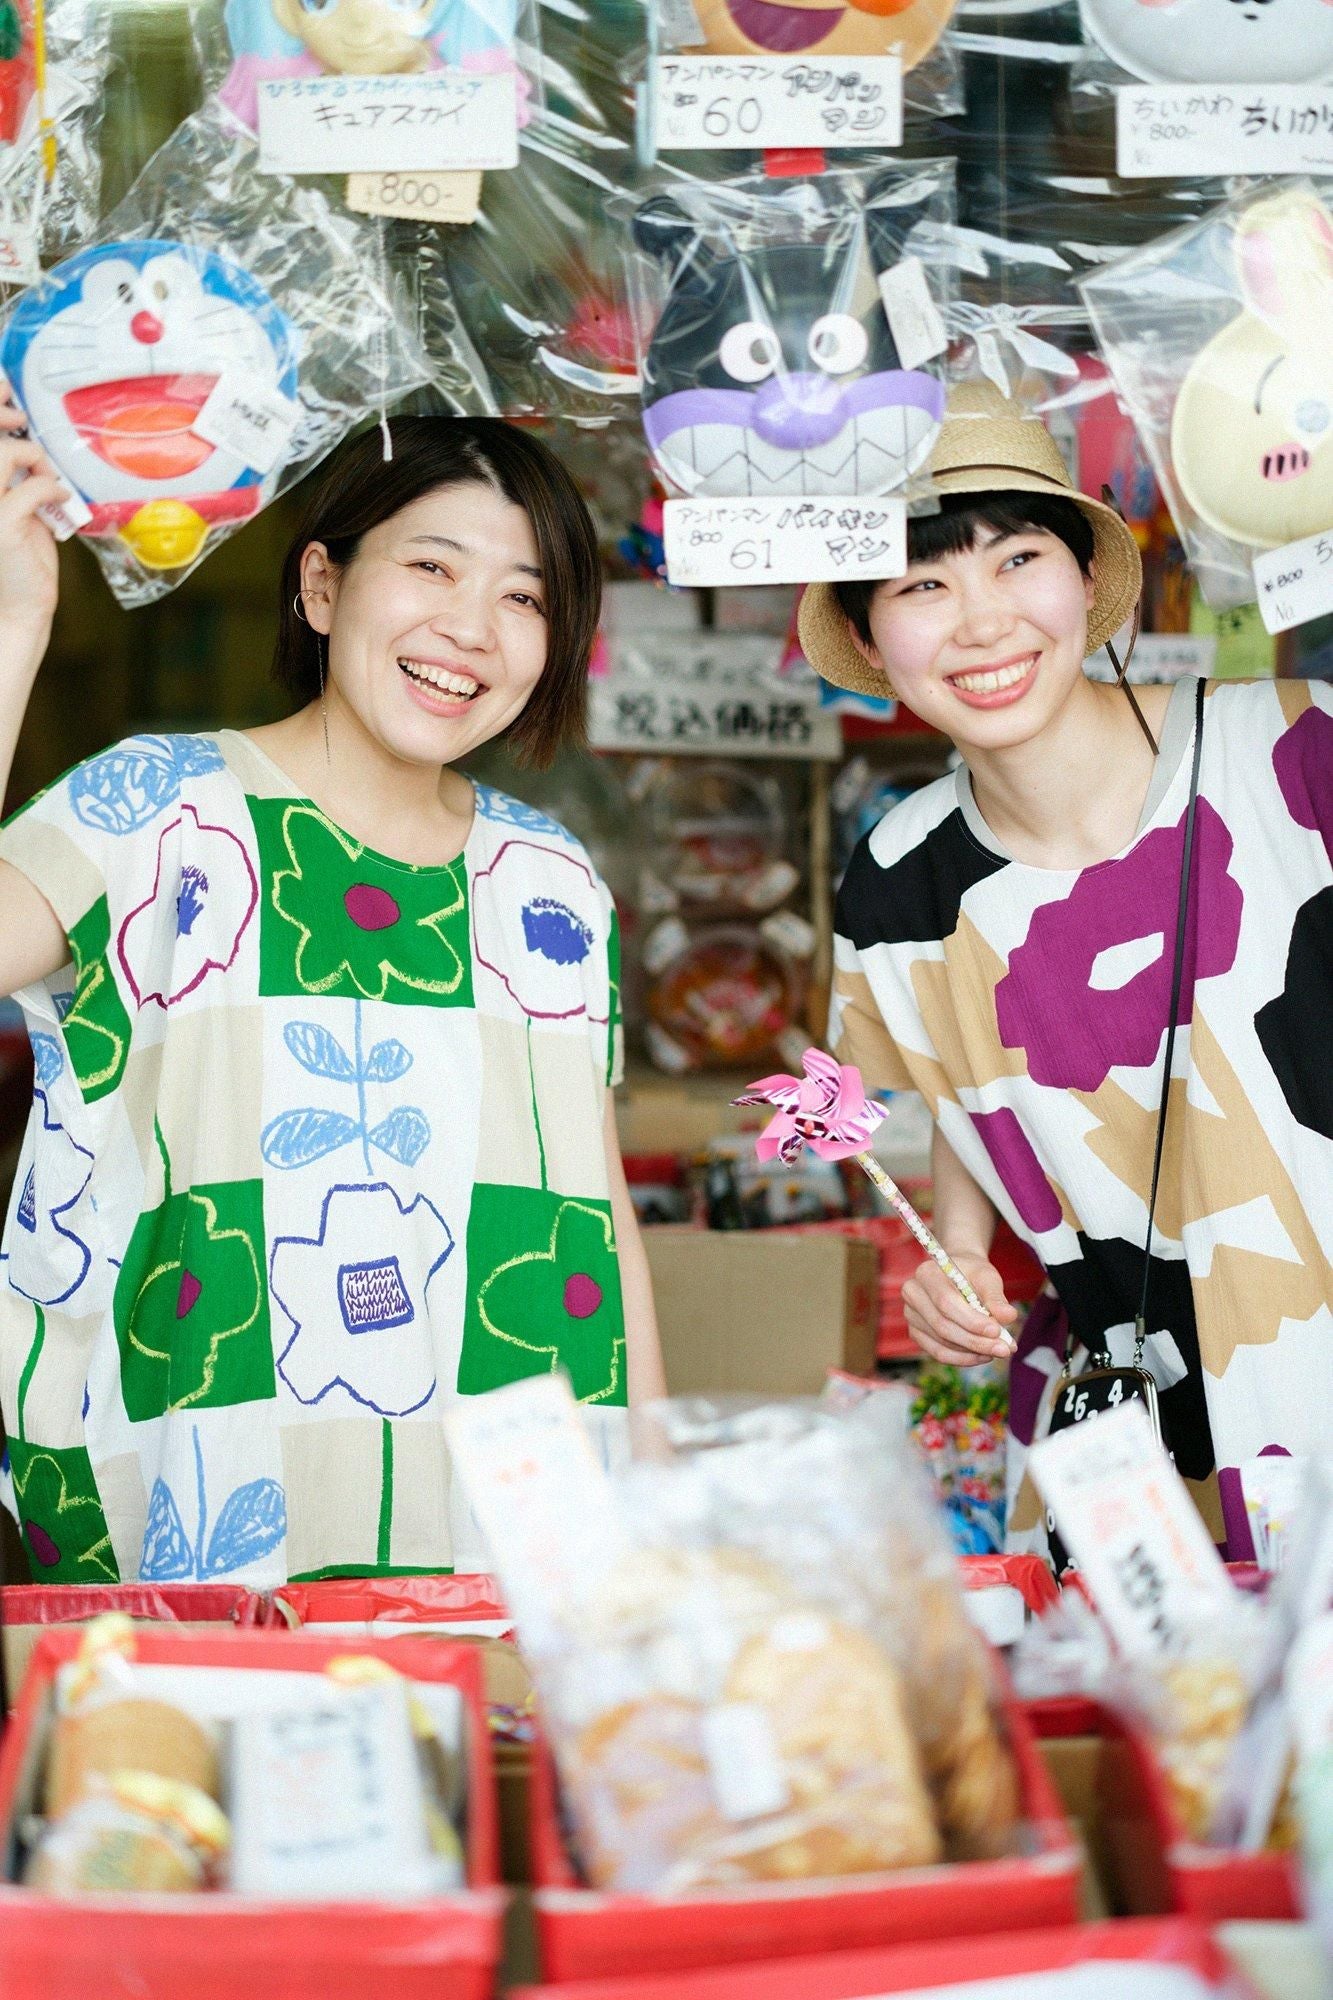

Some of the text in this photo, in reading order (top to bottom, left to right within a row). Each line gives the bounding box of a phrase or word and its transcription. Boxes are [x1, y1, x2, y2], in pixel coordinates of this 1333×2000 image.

[661, 65, 774, 83] アンパンマン
[313, 102, 468, 130] キュアスカイ
[703, 96, 762, 137] 60
[1133, 95, 1234, 120] ちいかわ
[676, 507, 772, 525] アンパンマン
[730, 539, 773, 570] 61
